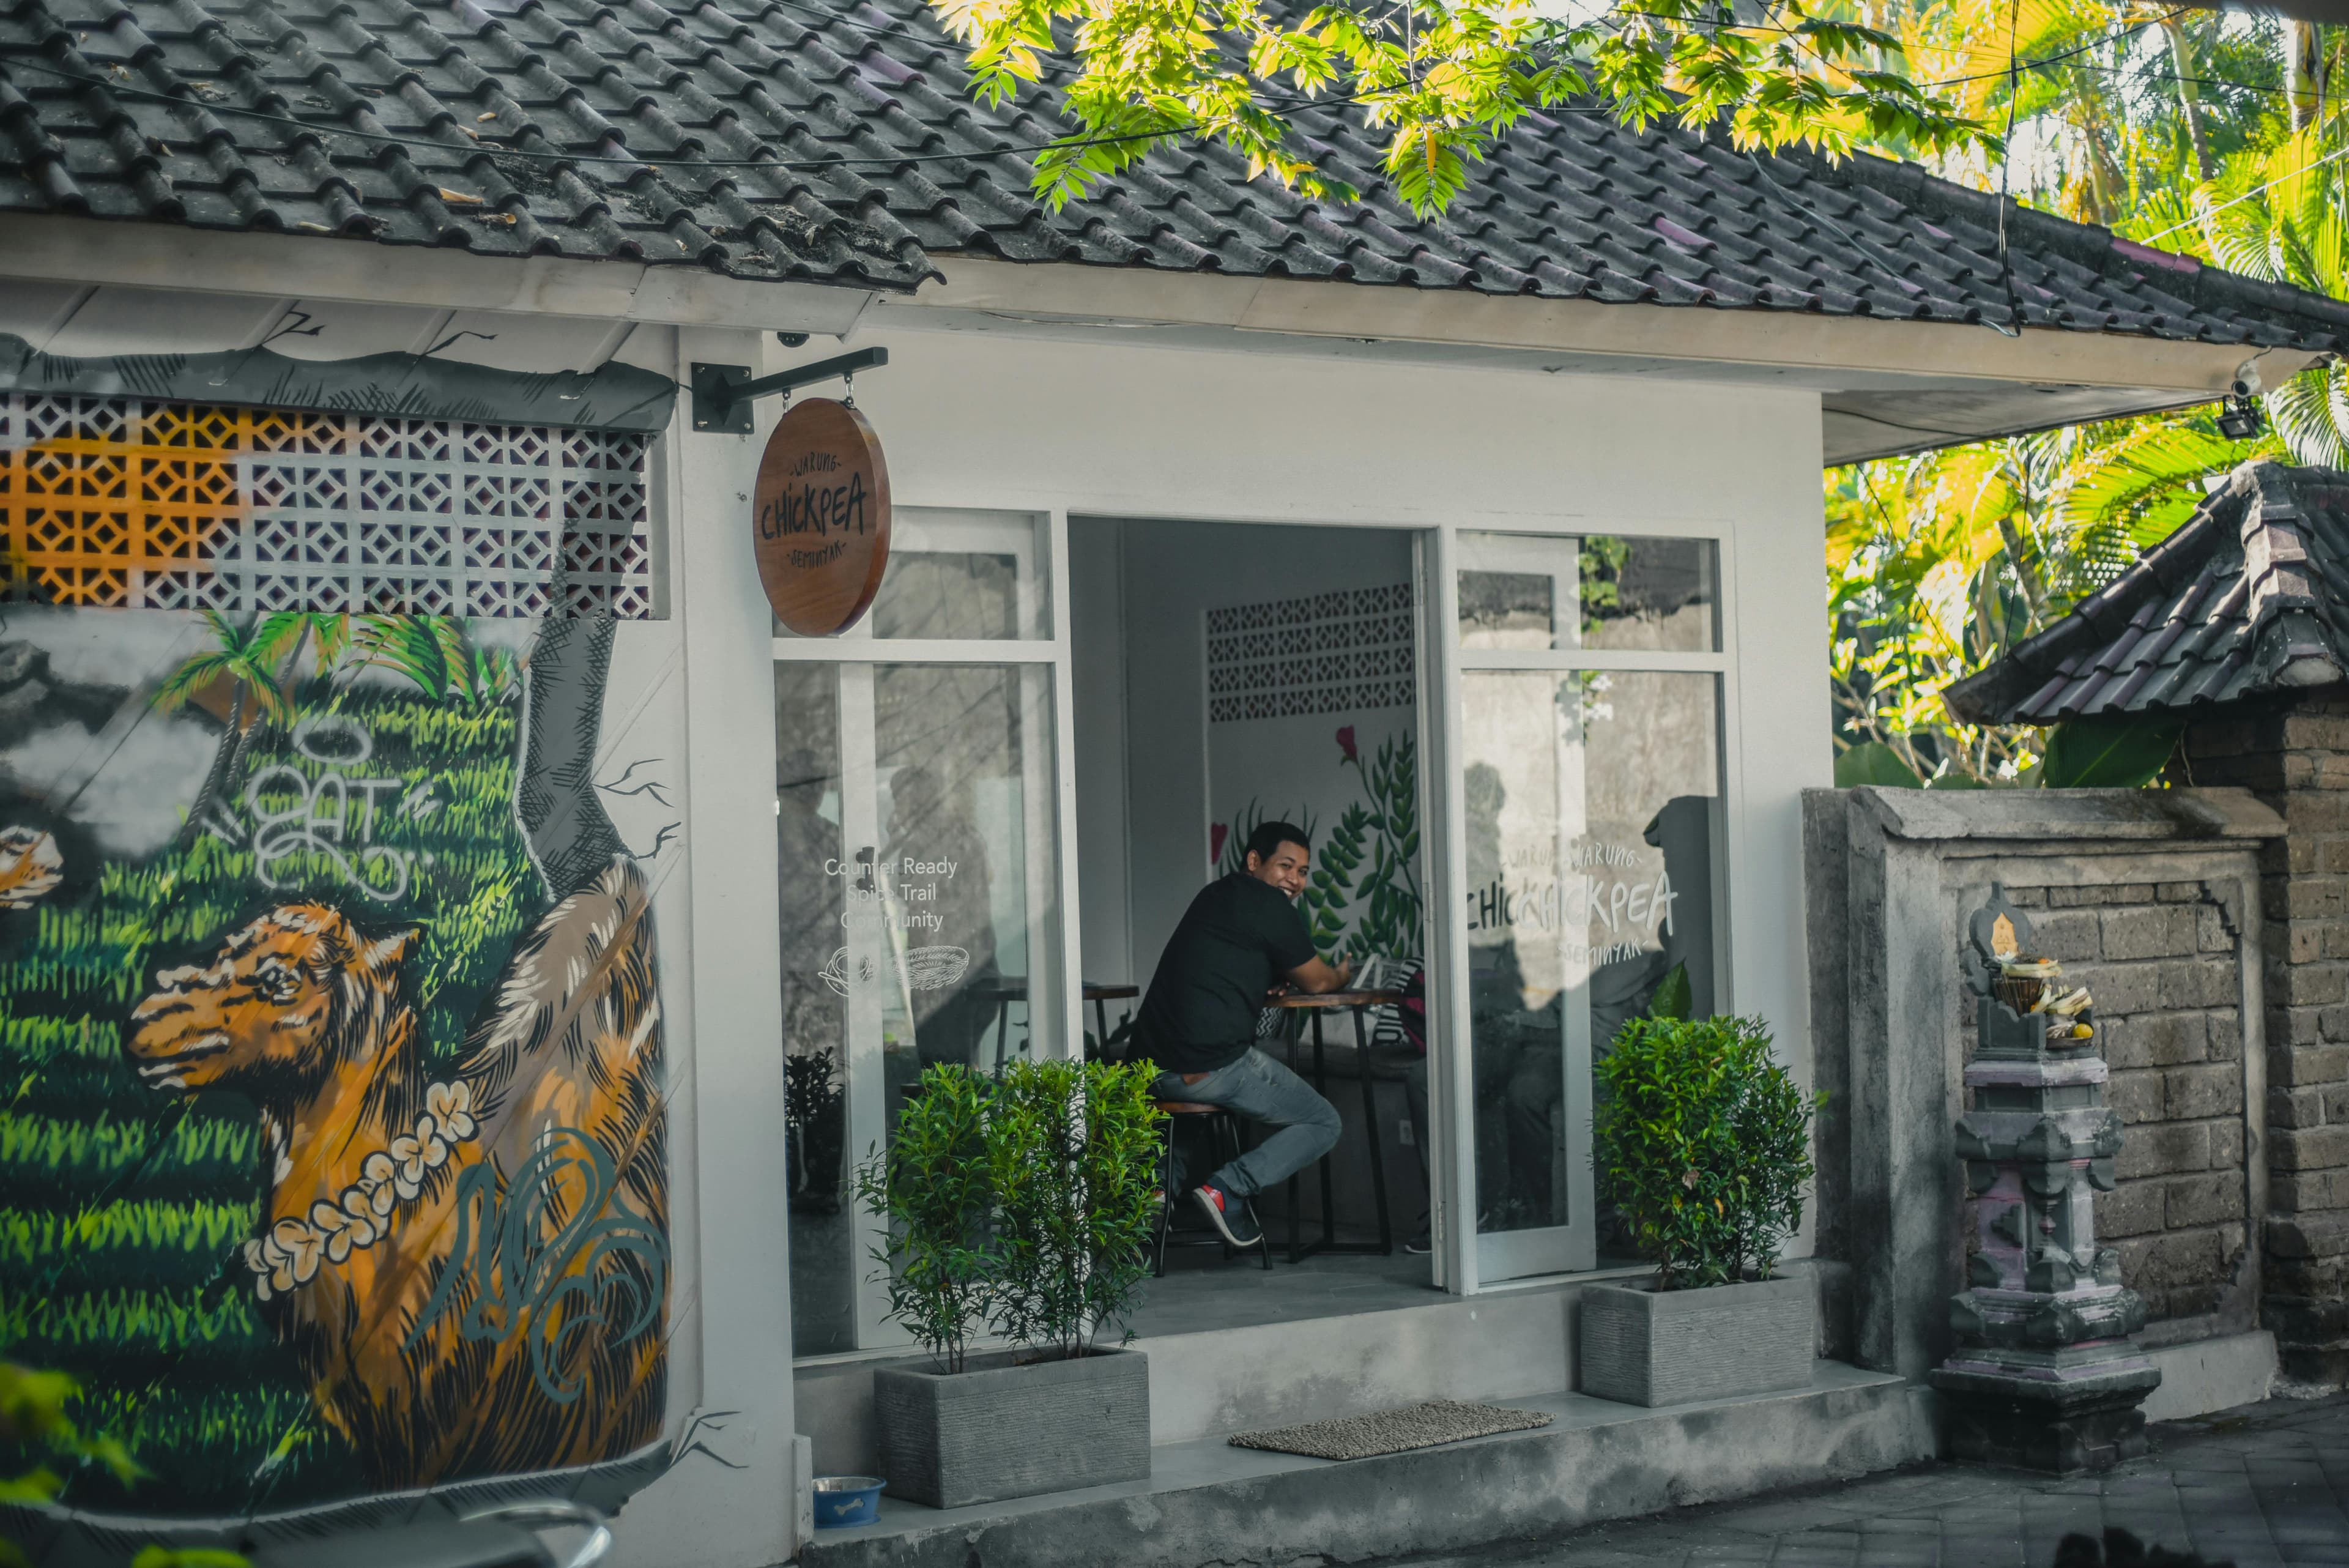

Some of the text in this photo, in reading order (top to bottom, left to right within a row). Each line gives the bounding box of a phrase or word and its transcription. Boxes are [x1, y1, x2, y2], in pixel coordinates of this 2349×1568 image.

[825, 856, 957, 878] Couner Ready
[900, 883, 936, 901] Trail
[841, 910, 944, 932] Counity
